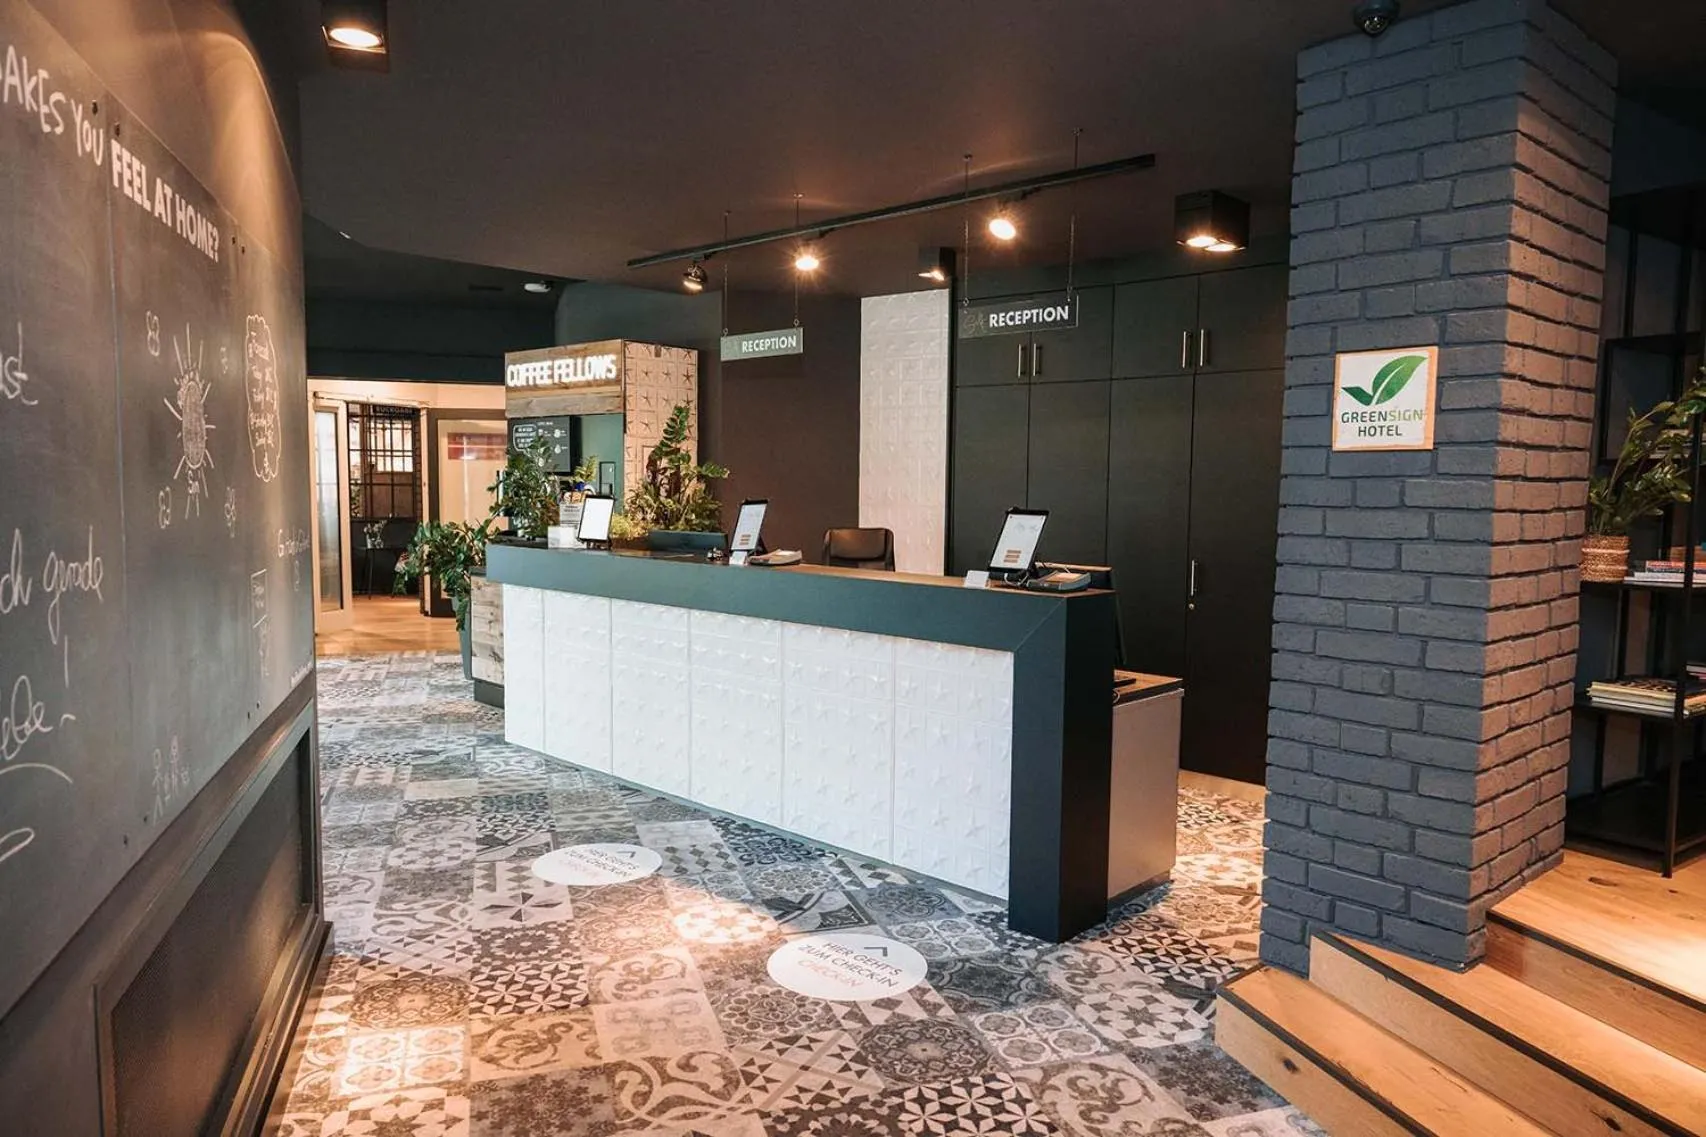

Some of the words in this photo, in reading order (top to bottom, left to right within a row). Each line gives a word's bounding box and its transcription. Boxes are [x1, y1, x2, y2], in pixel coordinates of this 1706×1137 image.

[0, 44, 66, 135] AKES
[111, 138, 152, 213] FEEL
[154, 177, 173, 228] AT
[175, 193, 219, 263] HOME?
[988, 305, 1069, 328] RECEPTION
[742, 335, 797, 353] RECEPTION
[506, 360, 553, 387] COFFEE
[553, 354, 617, 384] FELLOWS
[1341, 409, 1423, 424] GREENSIGN
[1358, 425, 1403, 438] HOTEL
[823, 942, 854, 958] HIER
[798, 944, 830, 961] ZUM
[831, 957, 900, 988] CHECK-IN
